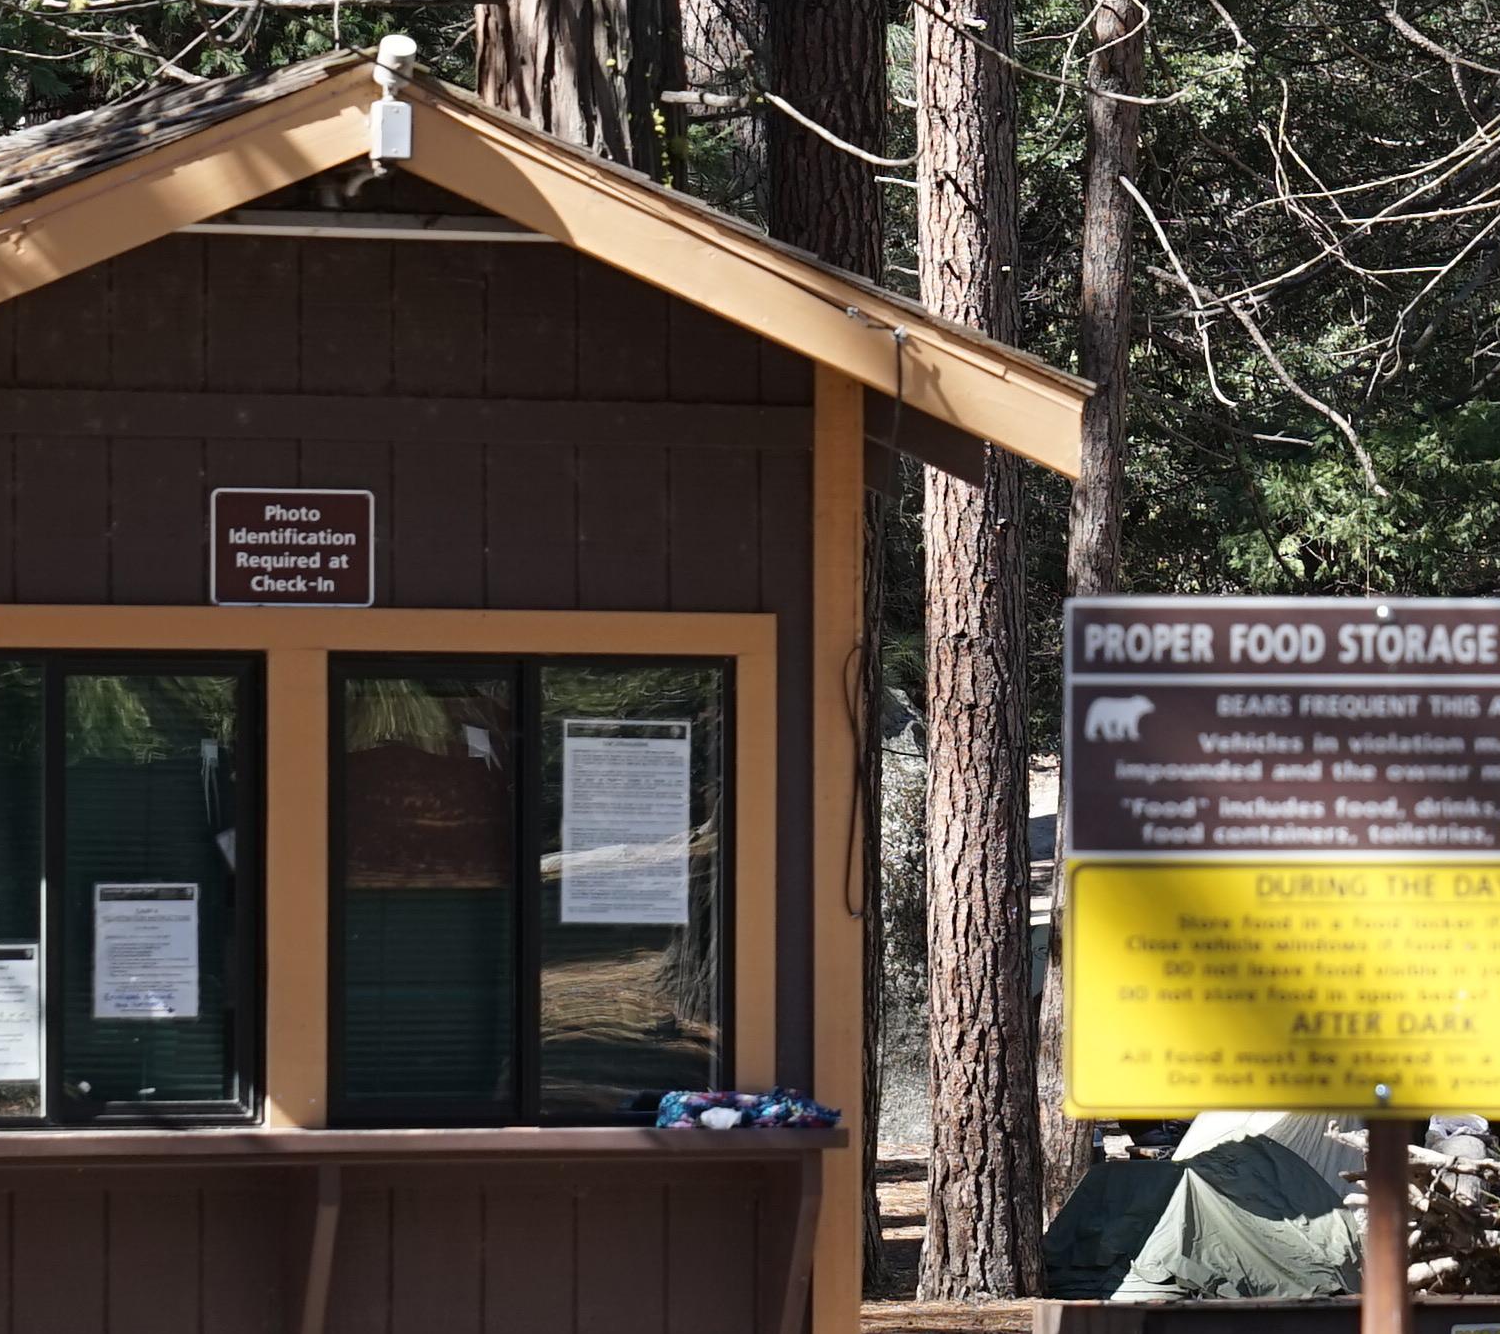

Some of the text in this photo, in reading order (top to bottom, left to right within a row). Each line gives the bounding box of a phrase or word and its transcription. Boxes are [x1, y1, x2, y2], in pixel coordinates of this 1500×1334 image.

[264, 505, 320, 522] Photo
[229, 528, 356, 546] Identification
[236, 552, 349, 572] Required at
[250, 575, 334, 592] Check-In
[1084, 623, 1215, 663] PROPER
[1230, 623, 1327, 663] FOOD
[1338, 623, 1499, 663] STORAGE
[1216, 694, 1291, 717] BEARS
[1299, 694, 1420, 720] FREQUENT
[1429, 694, 1481, 718] THIS
[1198, 731, 1303, 754] Vehicles
[1312, 732, 1339, 754] in
[1348, 732, 1465, 755] violation
[1114, 759, 1263, 785] impounded
[1271, 759, 1323, 782] and
[1332, 760, 1377, 782] the
[1385, 763, 1470, 783] owner
[1218, 796, 1325, 819] includes
[1335, 796, 1407, 820] food,
[1142, 822, 1205, 845] food
[1213, 823, 1358, 846] containers,
[1367, 823, 1495, 847] toiletries,
[1257, 874, 1367, 898] DURING
[1387, 874, 1436, 898] THE
[1291, 1012, 1477, 1036] AFTER DARK
